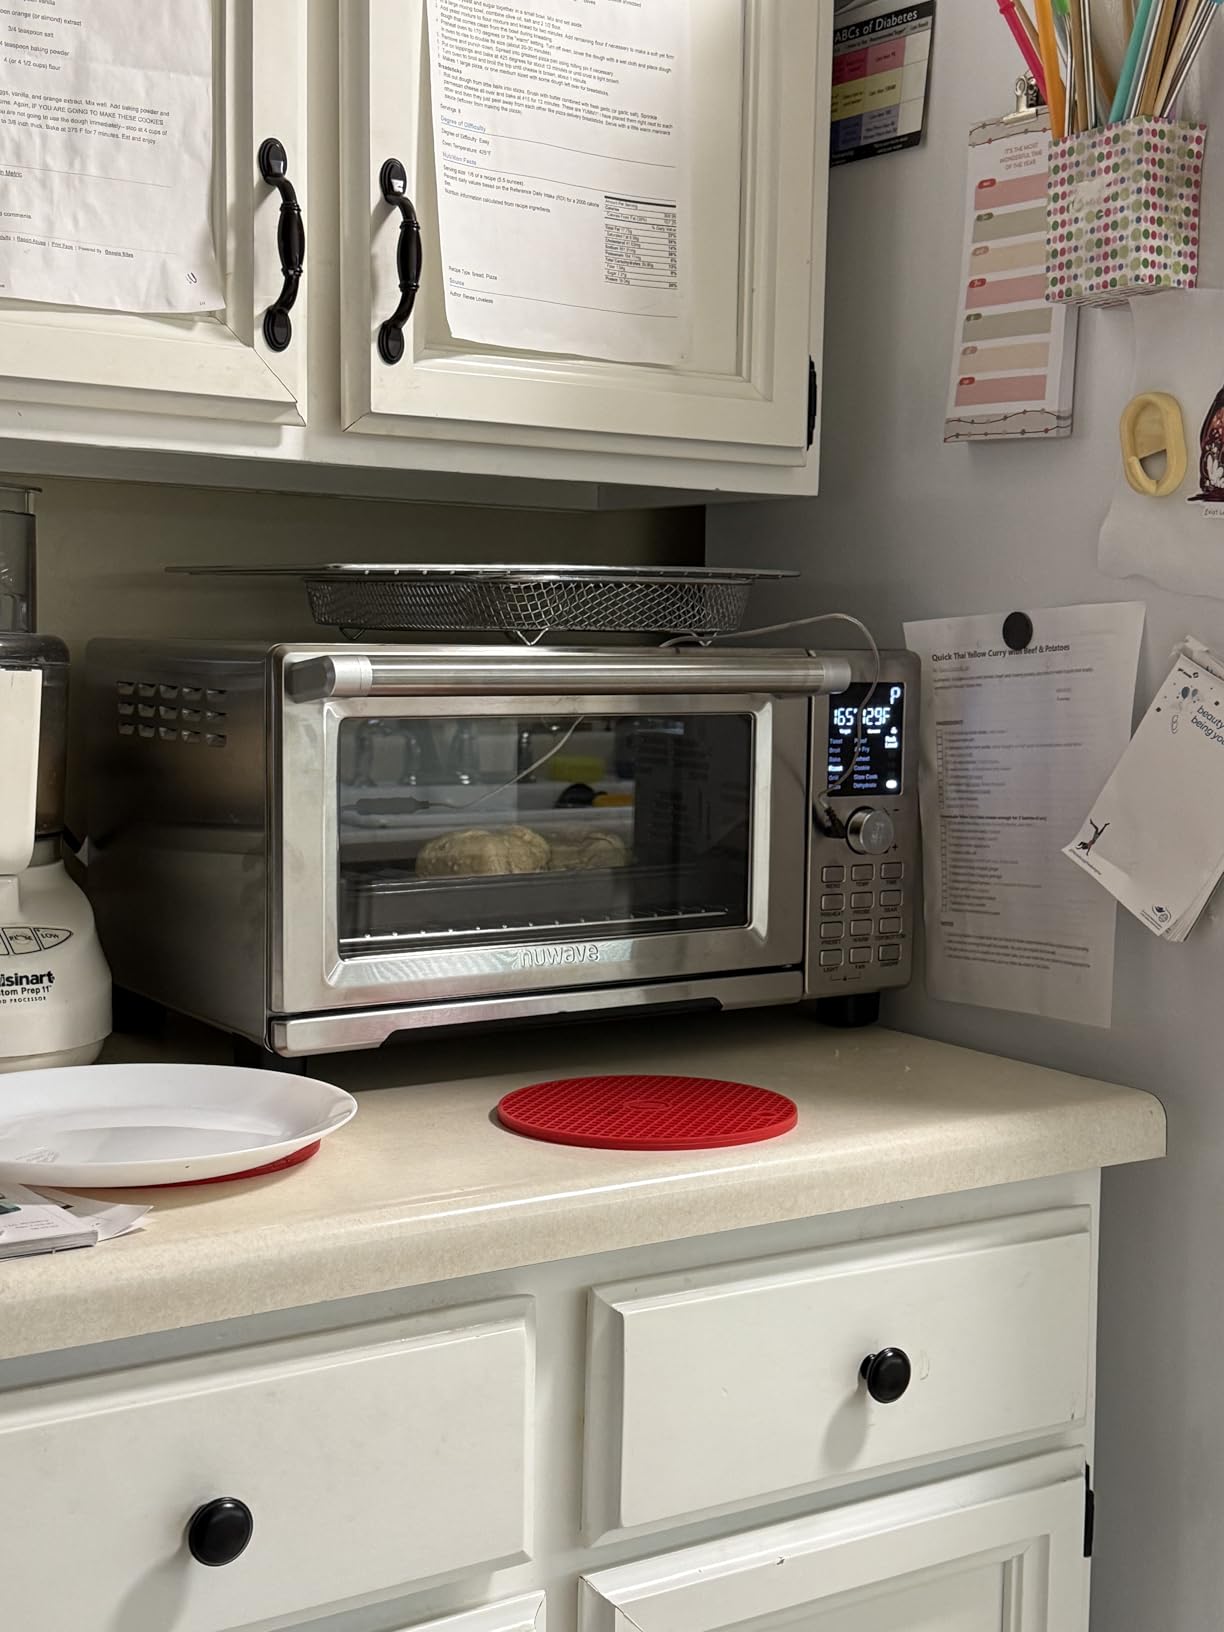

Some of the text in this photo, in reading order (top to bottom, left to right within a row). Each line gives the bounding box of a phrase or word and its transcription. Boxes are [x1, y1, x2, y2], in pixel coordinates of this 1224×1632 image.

[834, 27, 860, 42] ABCs
[863, 20, 874, 34] of
[875, 10, 918, 30] Diabetes
[67, 107, 88, 115] GOING
[100, 111, 116, 119] MAKE
[118, 113, 137, 122] THESE
[138, 116, 164, 125] COOKIES
[441, 115, 457, 127] Degree
[464, 122, 486, 134] Difficulty
[443, 151, 477, 166] Nutrition Facts
[449, 277, 465, 287] Source
[932, 654, 952, 662] Quick
[988, 649, 1006, 658] Curry
[1024, 646, 1037, 654] Beef
[1045, 644, 1070, 653] Potatoes
[1191, 716, 1213, 736] being
[520, 944, 599, 968] nuwave
[21, 987, 40, 995] Prep
